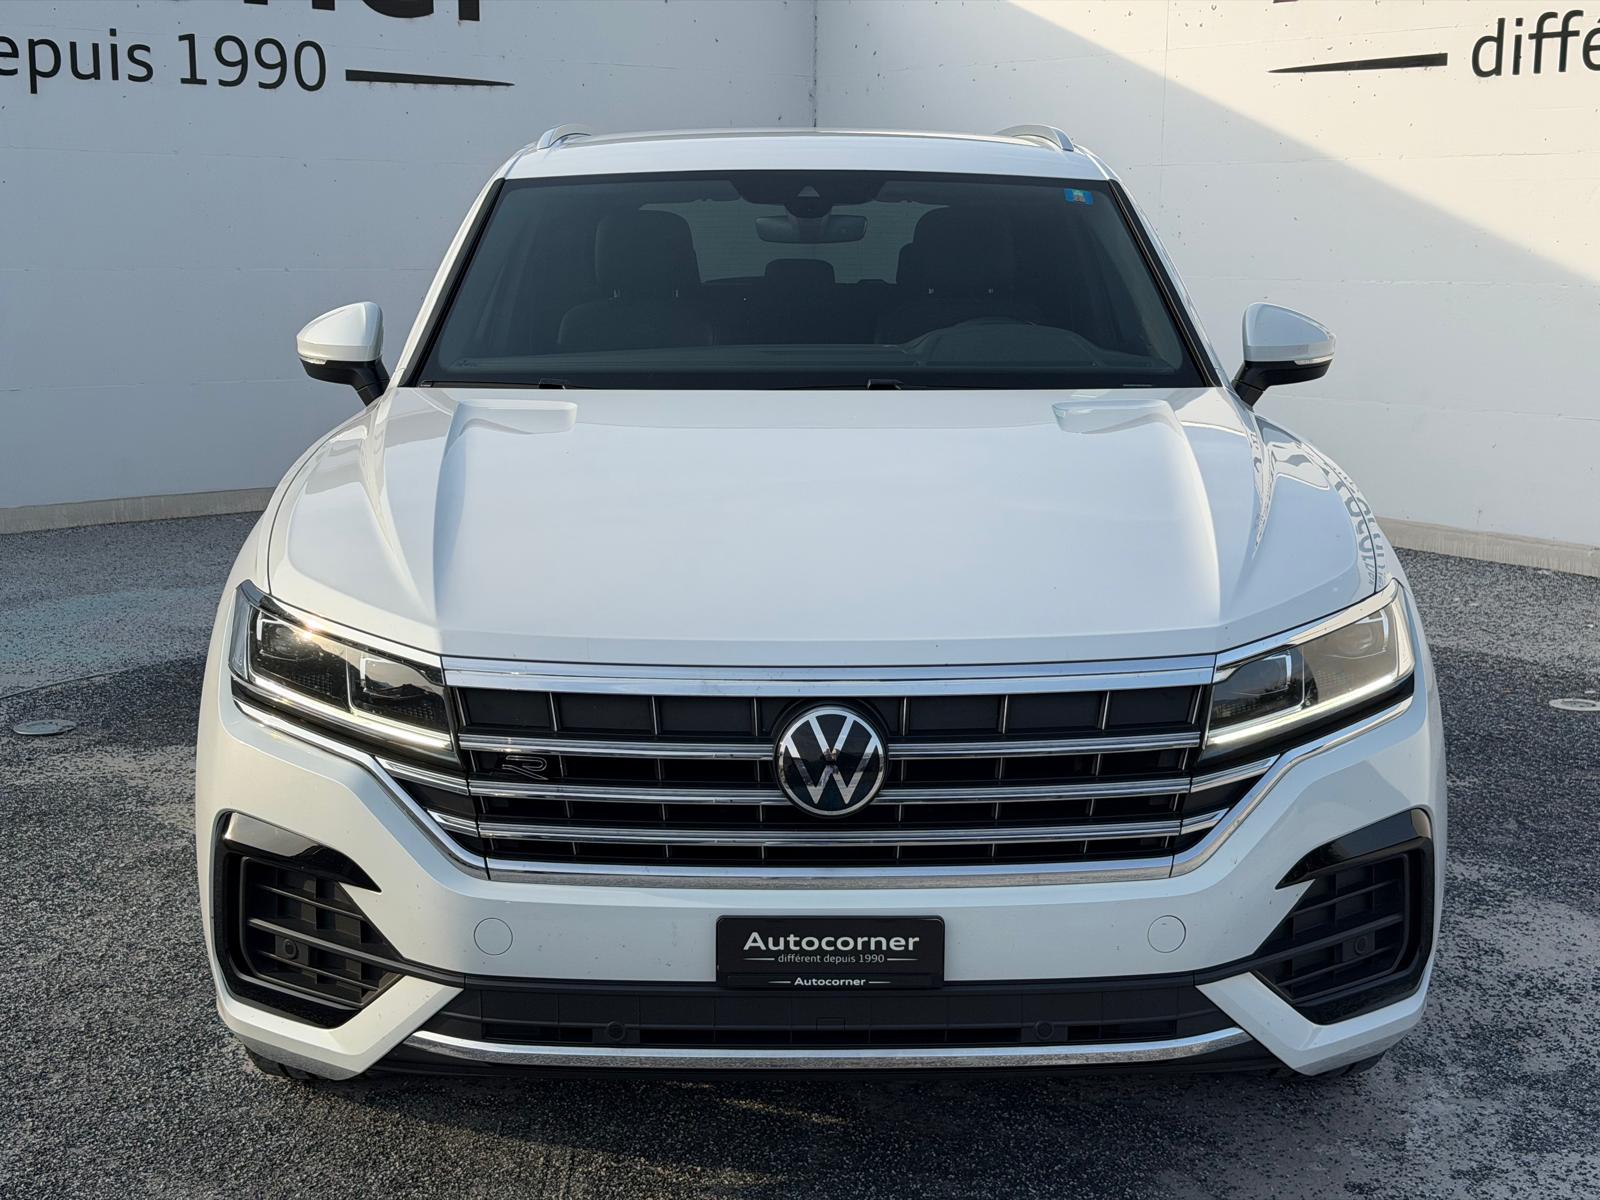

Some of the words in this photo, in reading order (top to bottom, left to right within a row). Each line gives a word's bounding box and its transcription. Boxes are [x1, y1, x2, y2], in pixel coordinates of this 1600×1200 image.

[177, 33, 327, 92] 1990
[501, 754, 549, 780] R
[779, 706, 885, 815] VW
[743, 931, 920, 951] Autocorner
[777, 953, 821, 963] différent
[823, 953, 856, 965] depuis
[858, 954, 885, 963] 1990
[794, 977, 866, 986] Autocorner
